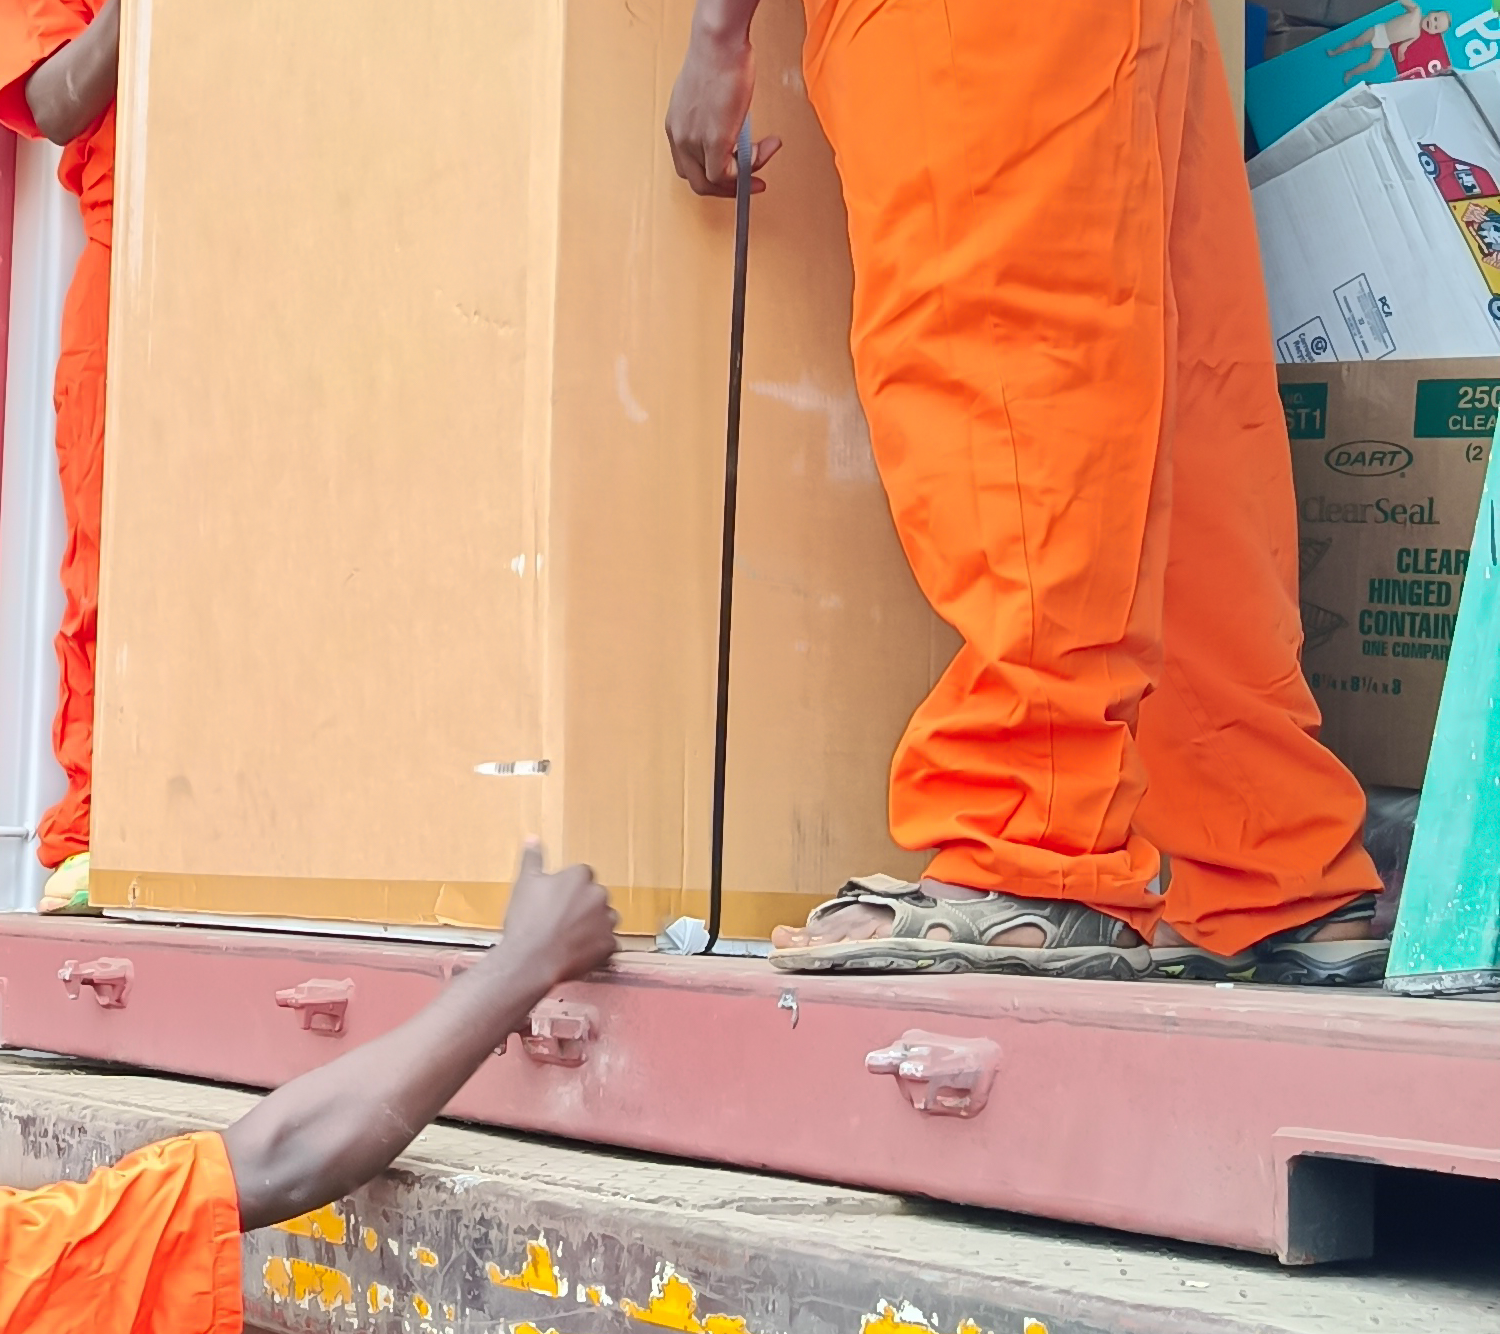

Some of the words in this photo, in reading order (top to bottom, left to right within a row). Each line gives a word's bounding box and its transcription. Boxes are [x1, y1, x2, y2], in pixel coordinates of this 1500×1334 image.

[1334, 450, 1402, 467] DART
[1301, 495, 1440, 525] ClearSeal
[1368, 578, 1452, 607] HINGED
[1362, 640, 1389, 657] ONE
